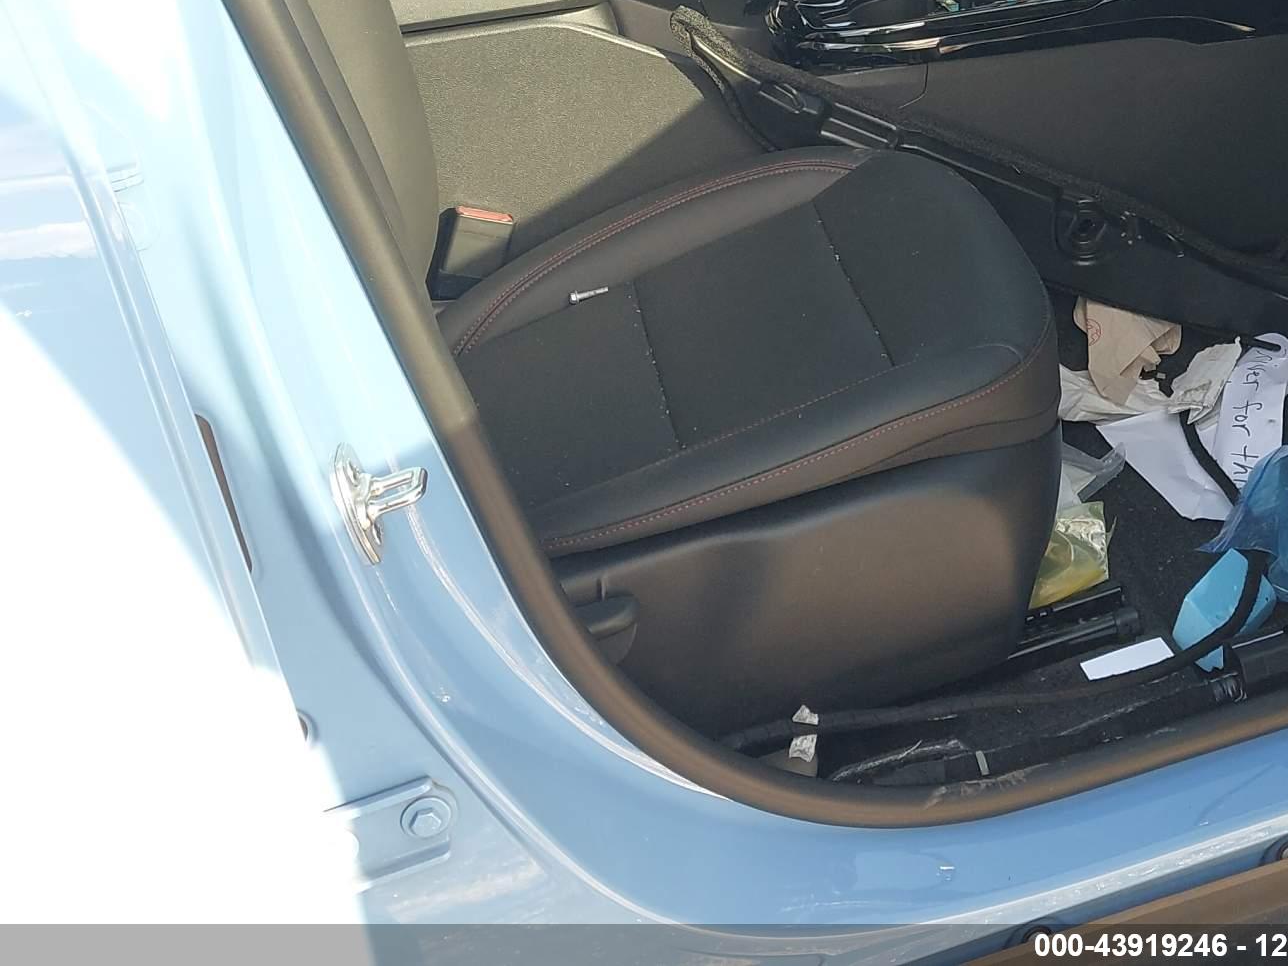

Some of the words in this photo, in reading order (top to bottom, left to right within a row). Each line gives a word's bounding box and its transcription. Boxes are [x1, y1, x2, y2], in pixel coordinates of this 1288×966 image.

[1241, 348, 1280, 391] river
[1231, 399, 1263, 437] for
[1230, 445, 1259, 490] thi
